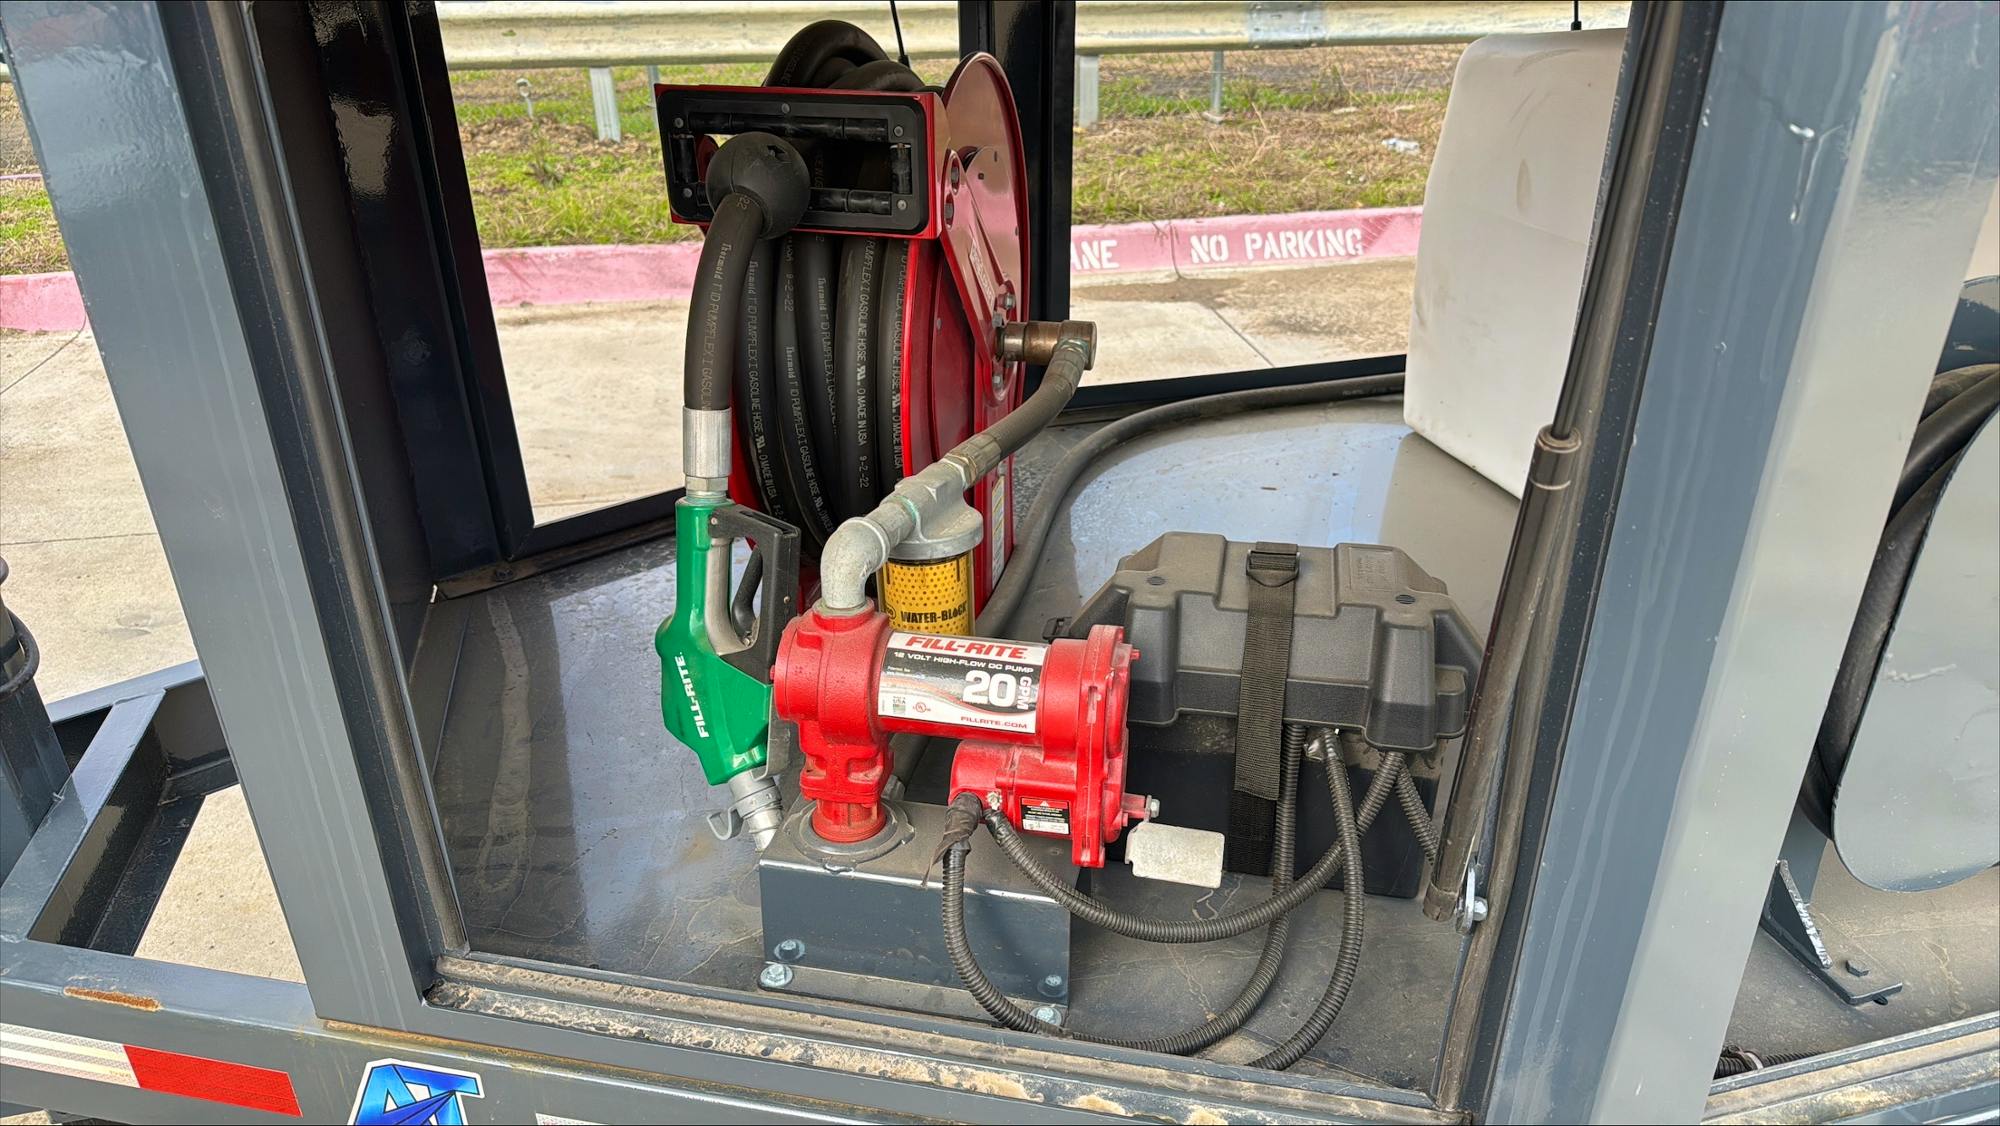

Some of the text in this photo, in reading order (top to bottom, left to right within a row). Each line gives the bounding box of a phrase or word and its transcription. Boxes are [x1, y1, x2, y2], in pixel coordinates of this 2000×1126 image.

[1190, 234, 1229, 264] NO
[1244, 228, 1363, 261] PARKING
[858, 294, 869, 337] GASOLINE
[859, 455, 870, 488] 9-2-22
[900, 601, 967, 623] WATER-BLOCK
[906, 635, 1028, 660] FILL-RITE
[907, 653, 931, 662] VOLT
[933, 656, 986, 669] HIGH-FLOW
[988, 662, 1003, 670] DC
[1005, 664, 1034, 674] PUMP
[675, 654, 710, 738] FILL-RITE
[963, 669, 1017, 708] 20
[1017, 676, 1032, 710] GPM
[961, 715, 1028, 729] FILLRITE.COM
